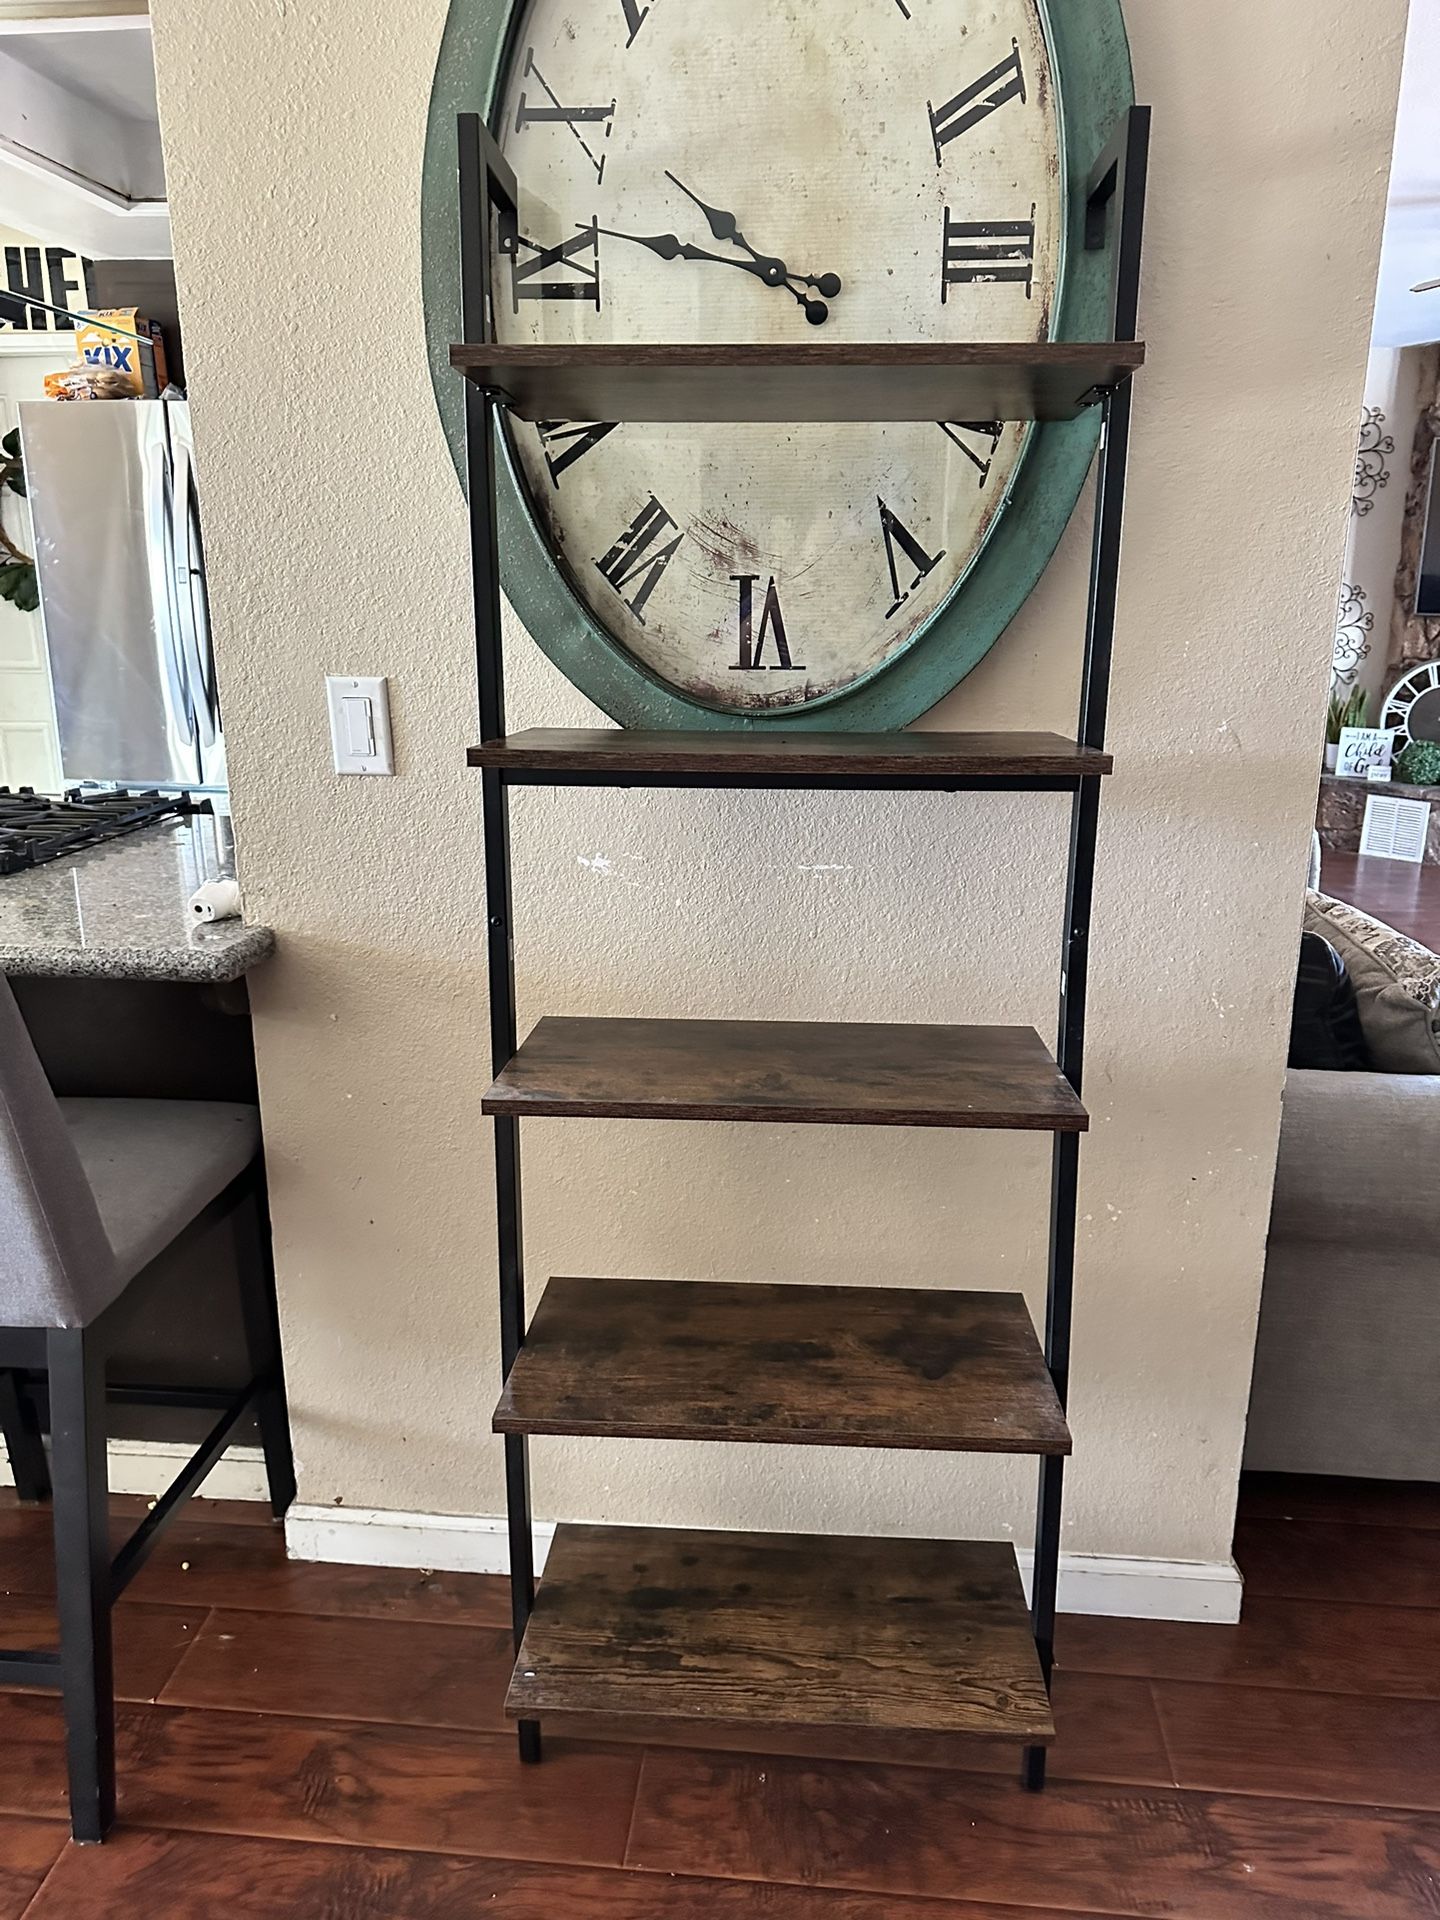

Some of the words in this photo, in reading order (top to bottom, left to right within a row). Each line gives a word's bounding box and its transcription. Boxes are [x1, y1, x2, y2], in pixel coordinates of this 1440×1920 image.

[515, 47, 617, 185] X
[509, 214, 601, 314] IX
[940, 203, 1037, 304] III
[84, 345, 132, 372] KIX
[876, 494, 947, 620] V
[727, 573, 807, 671] VI
[1344, 742, 1386, 758] Child
[1361, 732, 1371, 741] AM
